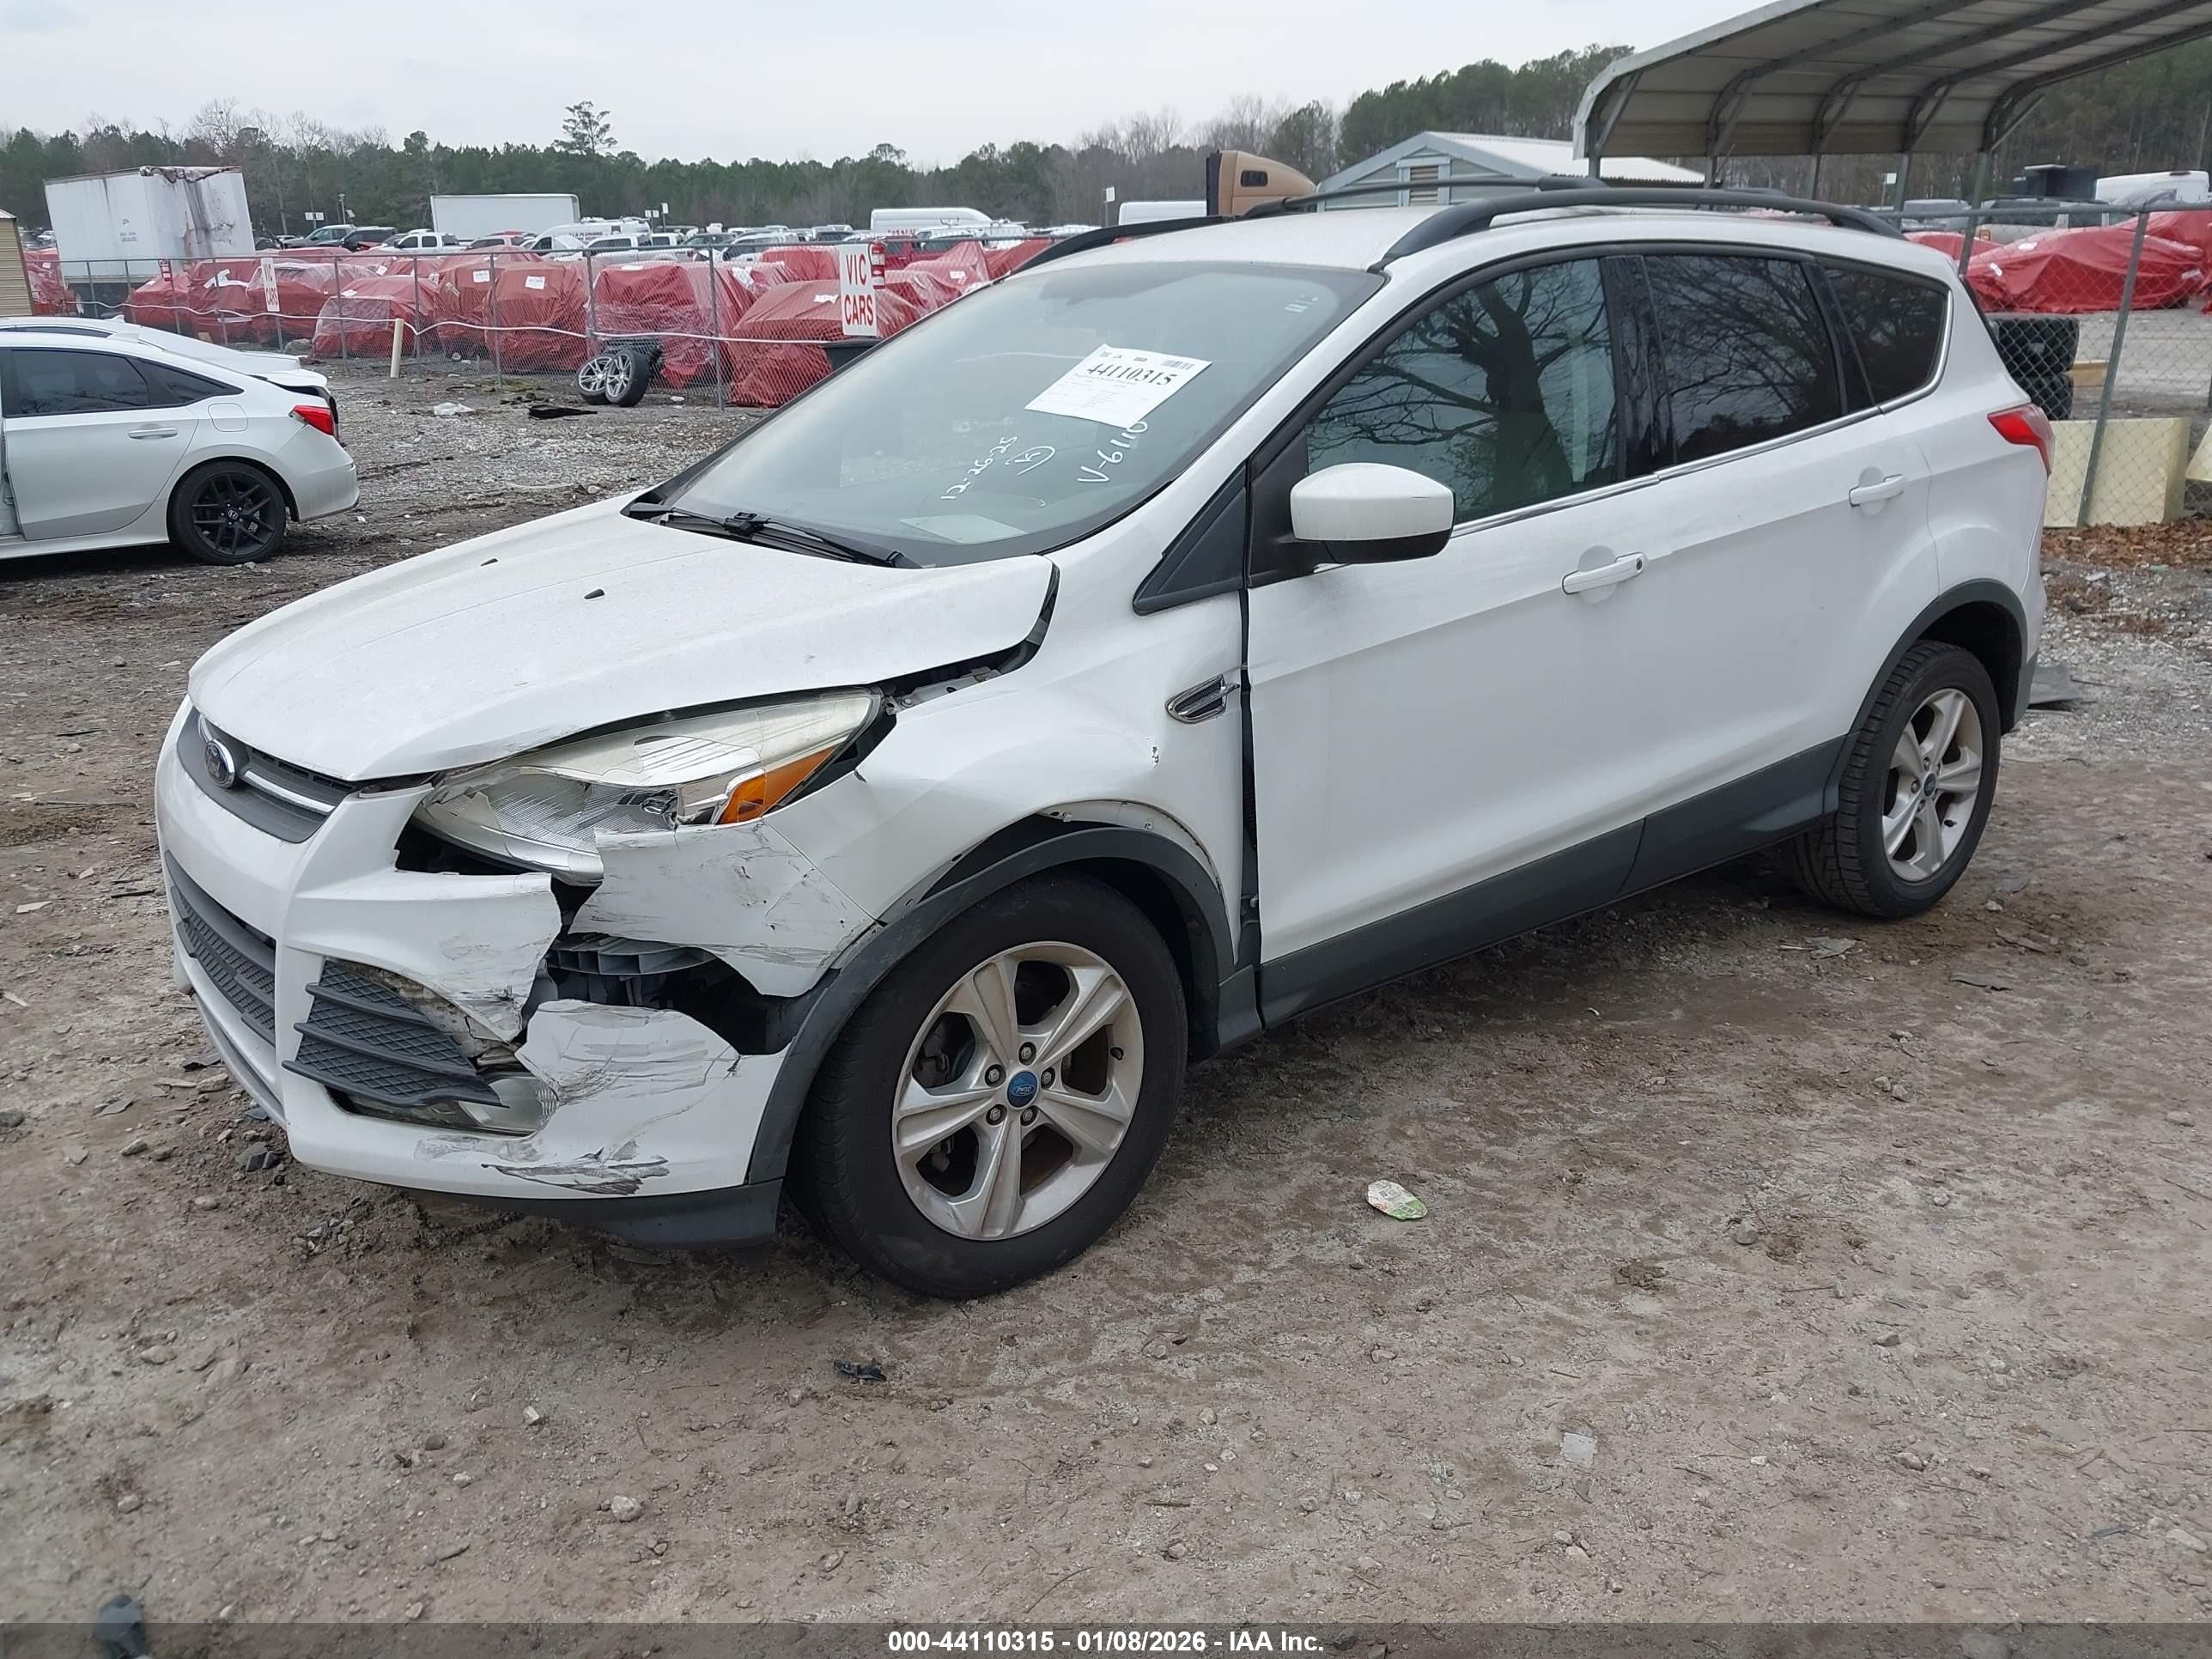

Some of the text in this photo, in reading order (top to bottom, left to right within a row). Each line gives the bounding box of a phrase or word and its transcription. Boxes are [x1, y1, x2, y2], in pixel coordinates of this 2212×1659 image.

[846, 253, 866, 285] VIC
[844, 294, 874, 326] CARS
[1086, 362, 1181, 386] 44110315
[1076, 421, 1148, 483] V-6110
